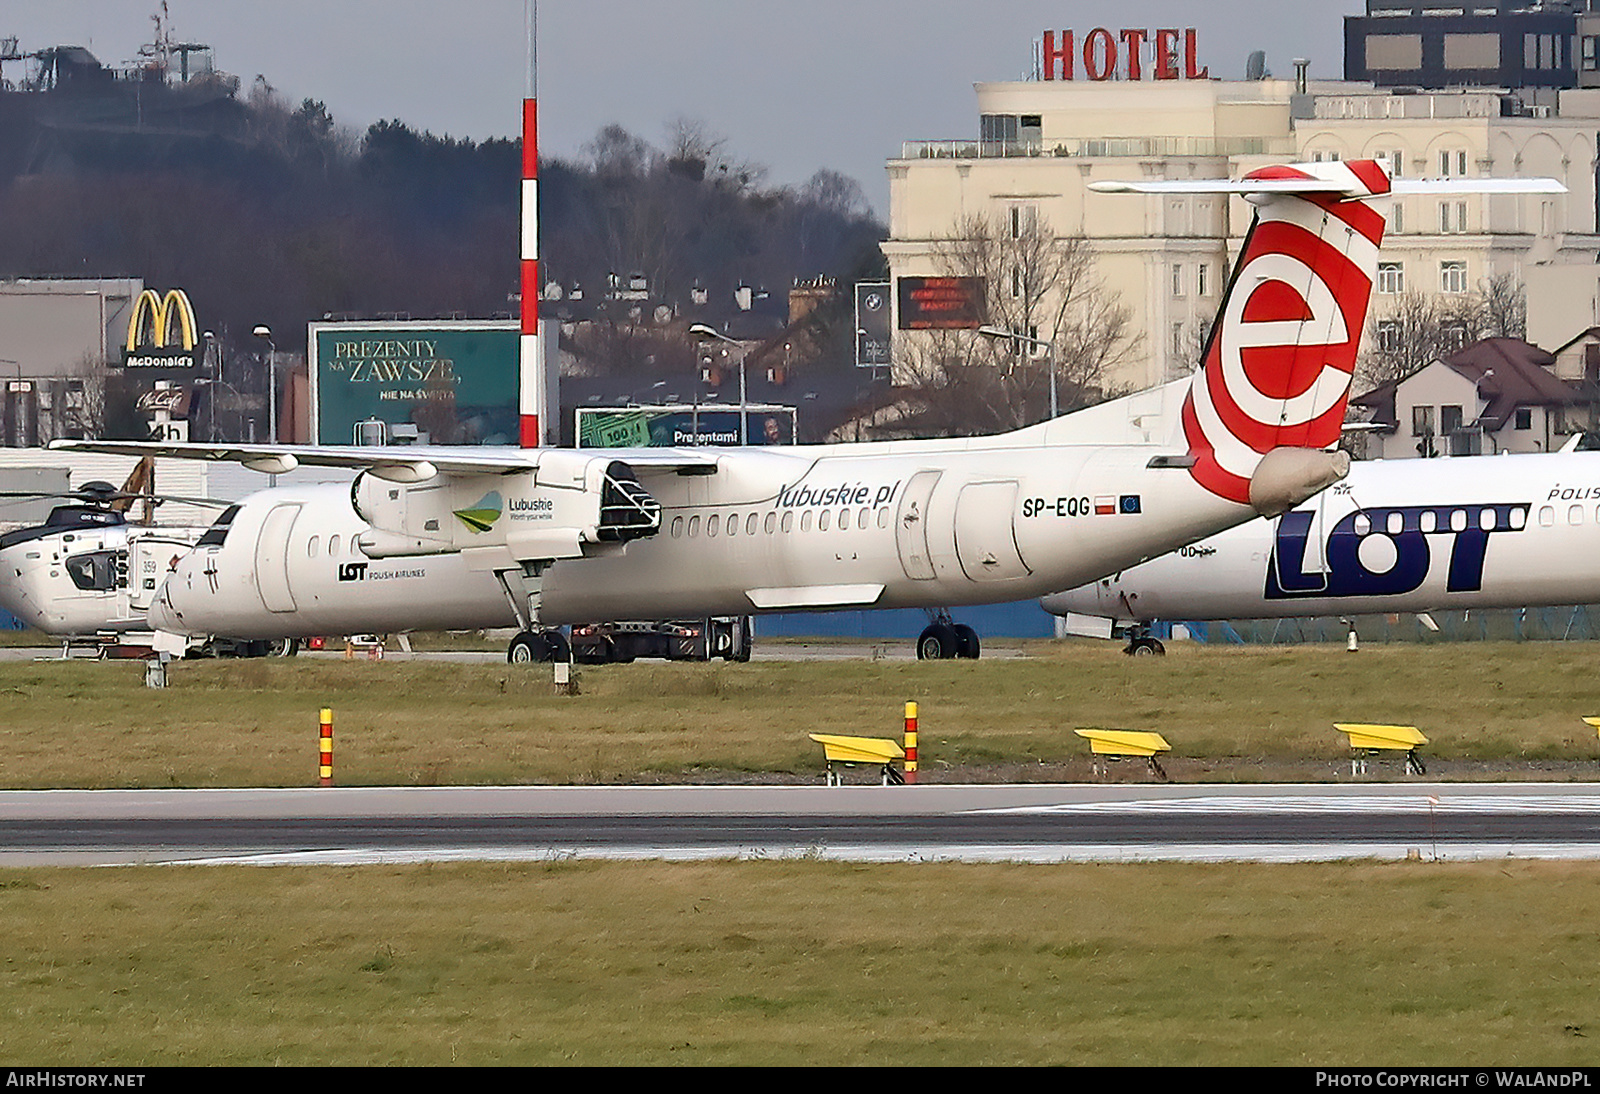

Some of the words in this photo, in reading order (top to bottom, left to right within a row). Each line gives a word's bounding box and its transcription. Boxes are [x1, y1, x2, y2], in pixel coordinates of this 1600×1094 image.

[1043, 28, 1208, 80] HOTEL
[335, 340, 437, 358] PREZENTY
[127, 356, 194, 367] McDonald's
[328, 361, 345, 371] NA
[349, 359, 462, 384] ZAWSZE,
[379, 390, 398, 400] NIE
[399, 390, 415, 400] NA
[509, 497, 553, 511] Lubuskie
[775, 480, 902, 509] lubuskie.pl
[1022, 497, 1091, 517] SP-EQG
[1264, 503, 1532, 598] LOT
[339, 562, 369, 581] LOT
